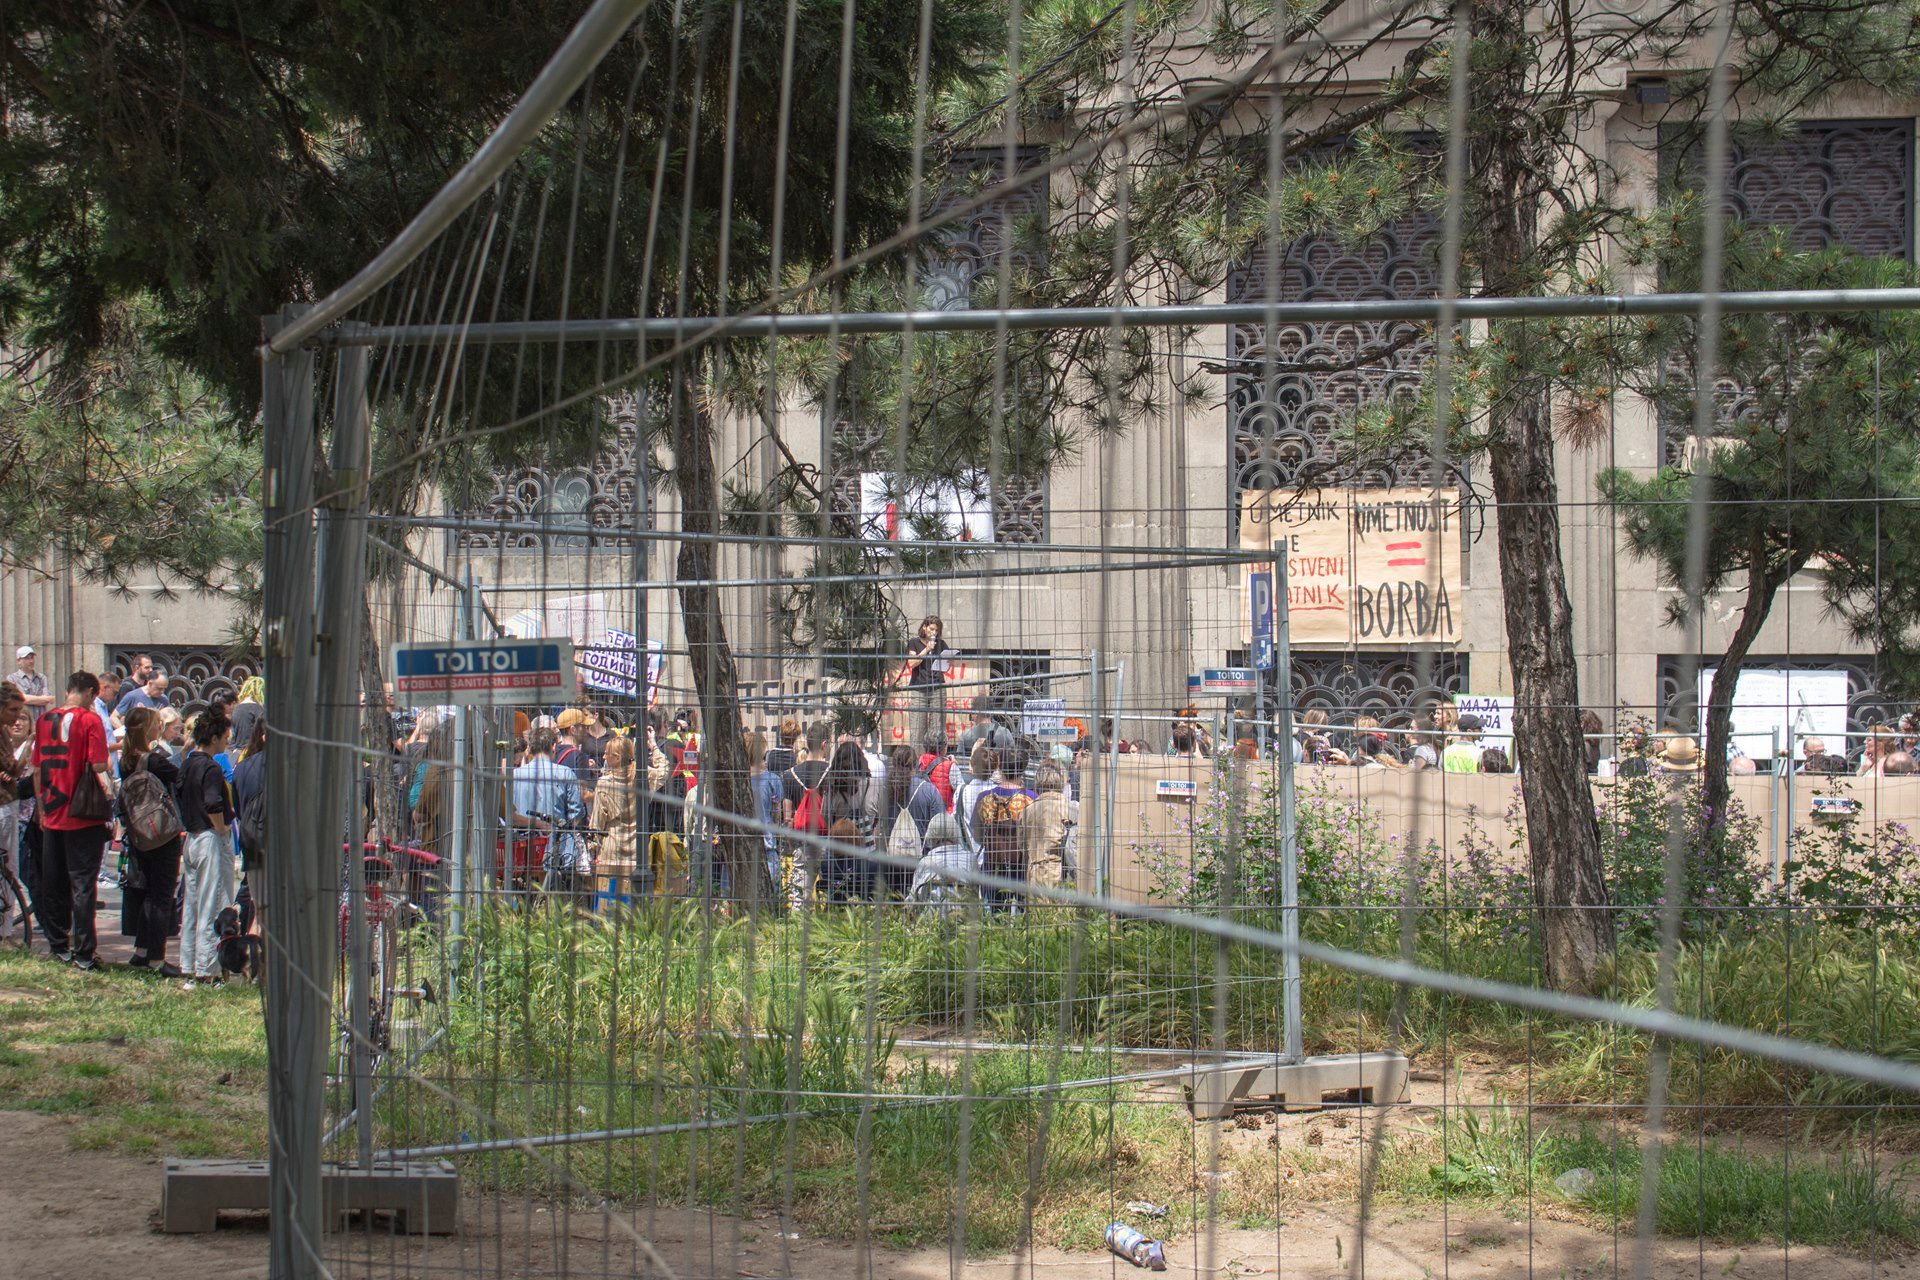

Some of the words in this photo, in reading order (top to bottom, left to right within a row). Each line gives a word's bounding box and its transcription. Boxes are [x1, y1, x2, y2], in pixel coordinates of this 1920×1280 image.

[1355, 499, 1451, 534] UMETNOST
[1357, 577, 1453, 638] BORBA
[434, 652, 474, 673] TOI
[478, 650, 519, 671] TOI
[400, 678, 447, 690] MOBILNI
[450, 675, 510, 690] SANITARNI
[512, 674, 558, 687] SISTEMI
[1217, 671, 1230, 680] TOI
[1231, 671, 1245, 680] TOI
[1459, 698, 1500, 713] MAJA
